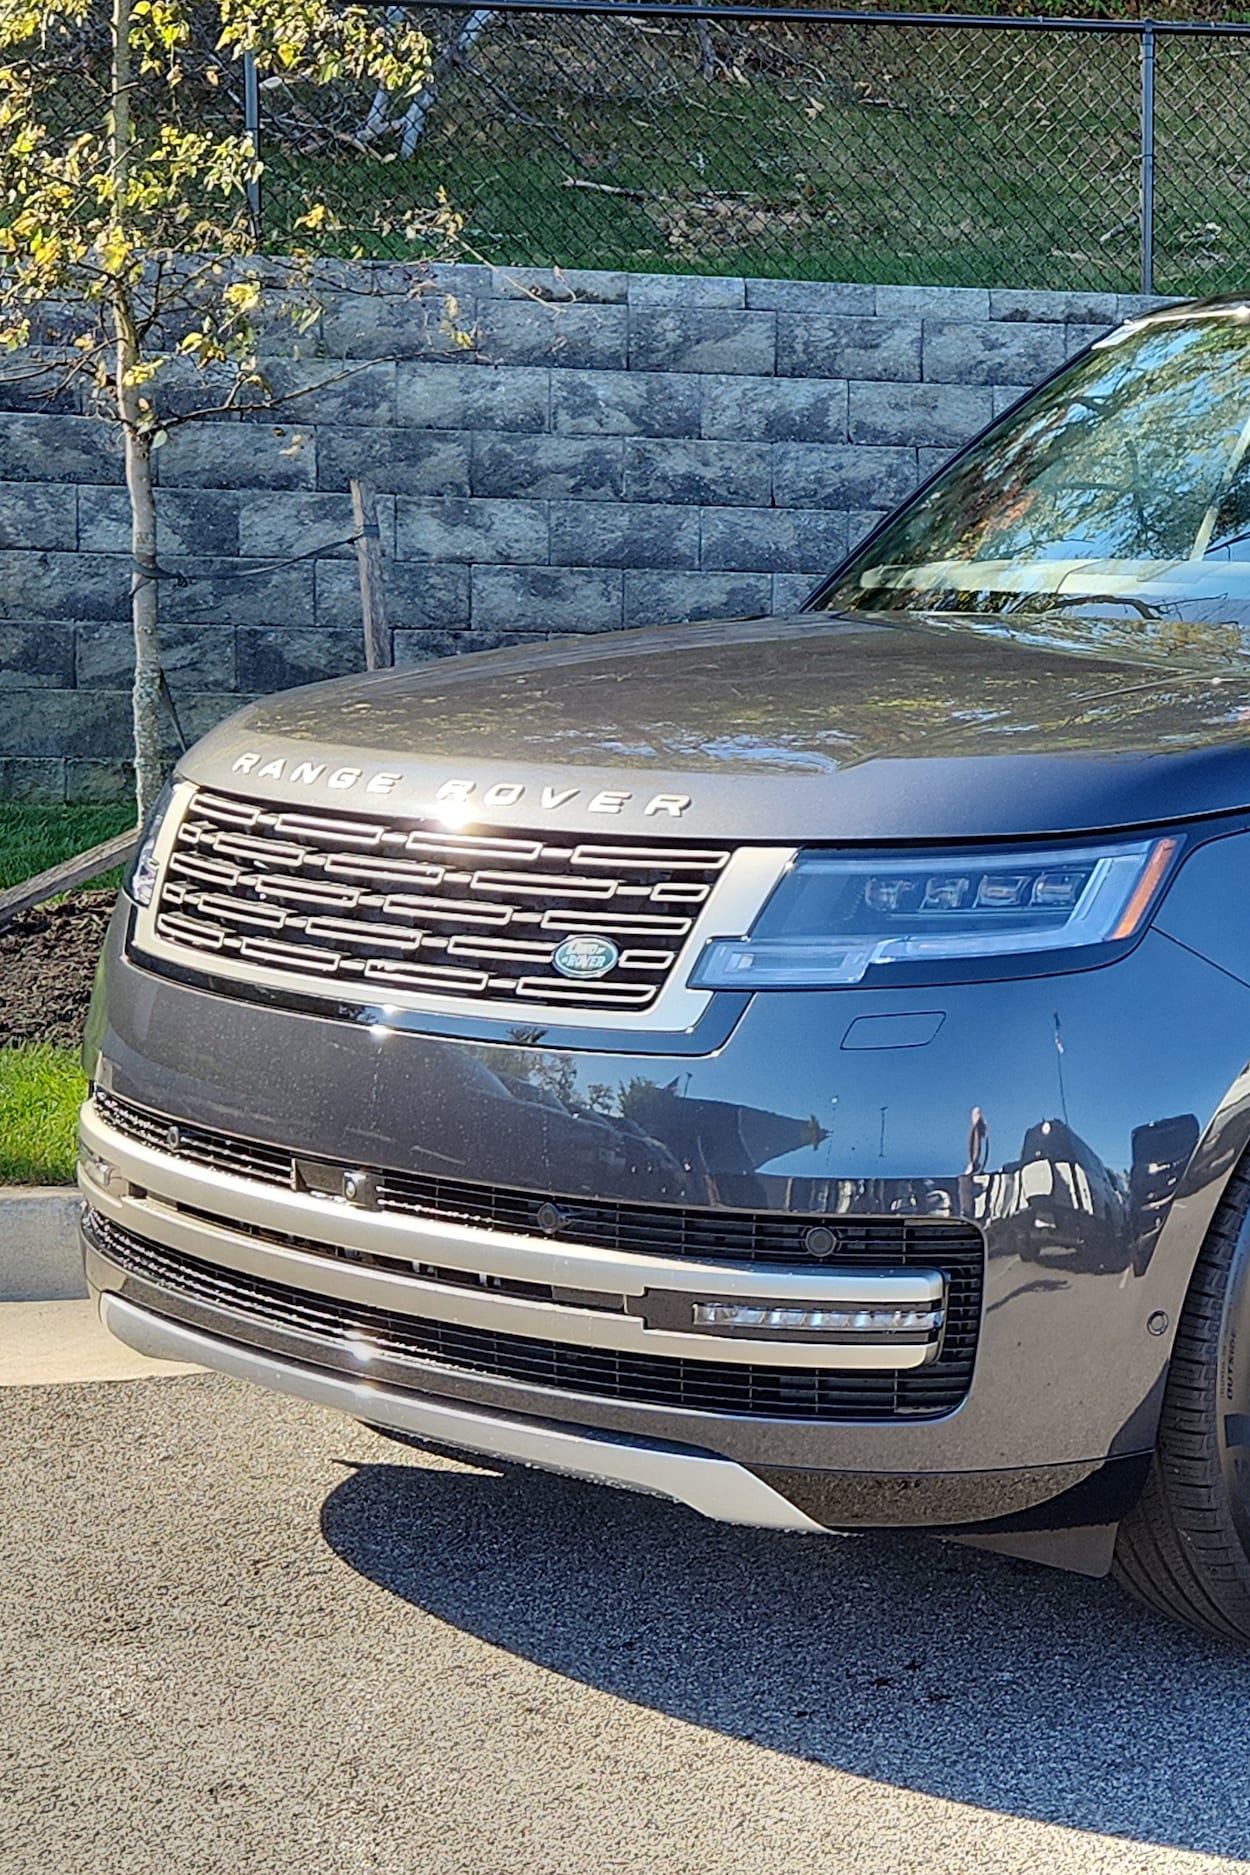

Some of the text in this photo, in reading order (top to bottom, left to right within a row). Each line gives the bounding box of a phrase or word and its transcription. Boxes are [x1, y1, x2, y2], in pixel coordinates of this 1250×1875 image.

[231, 752, 693, 818] RANGE ROVER
[566, 942, 600, 955] LD
